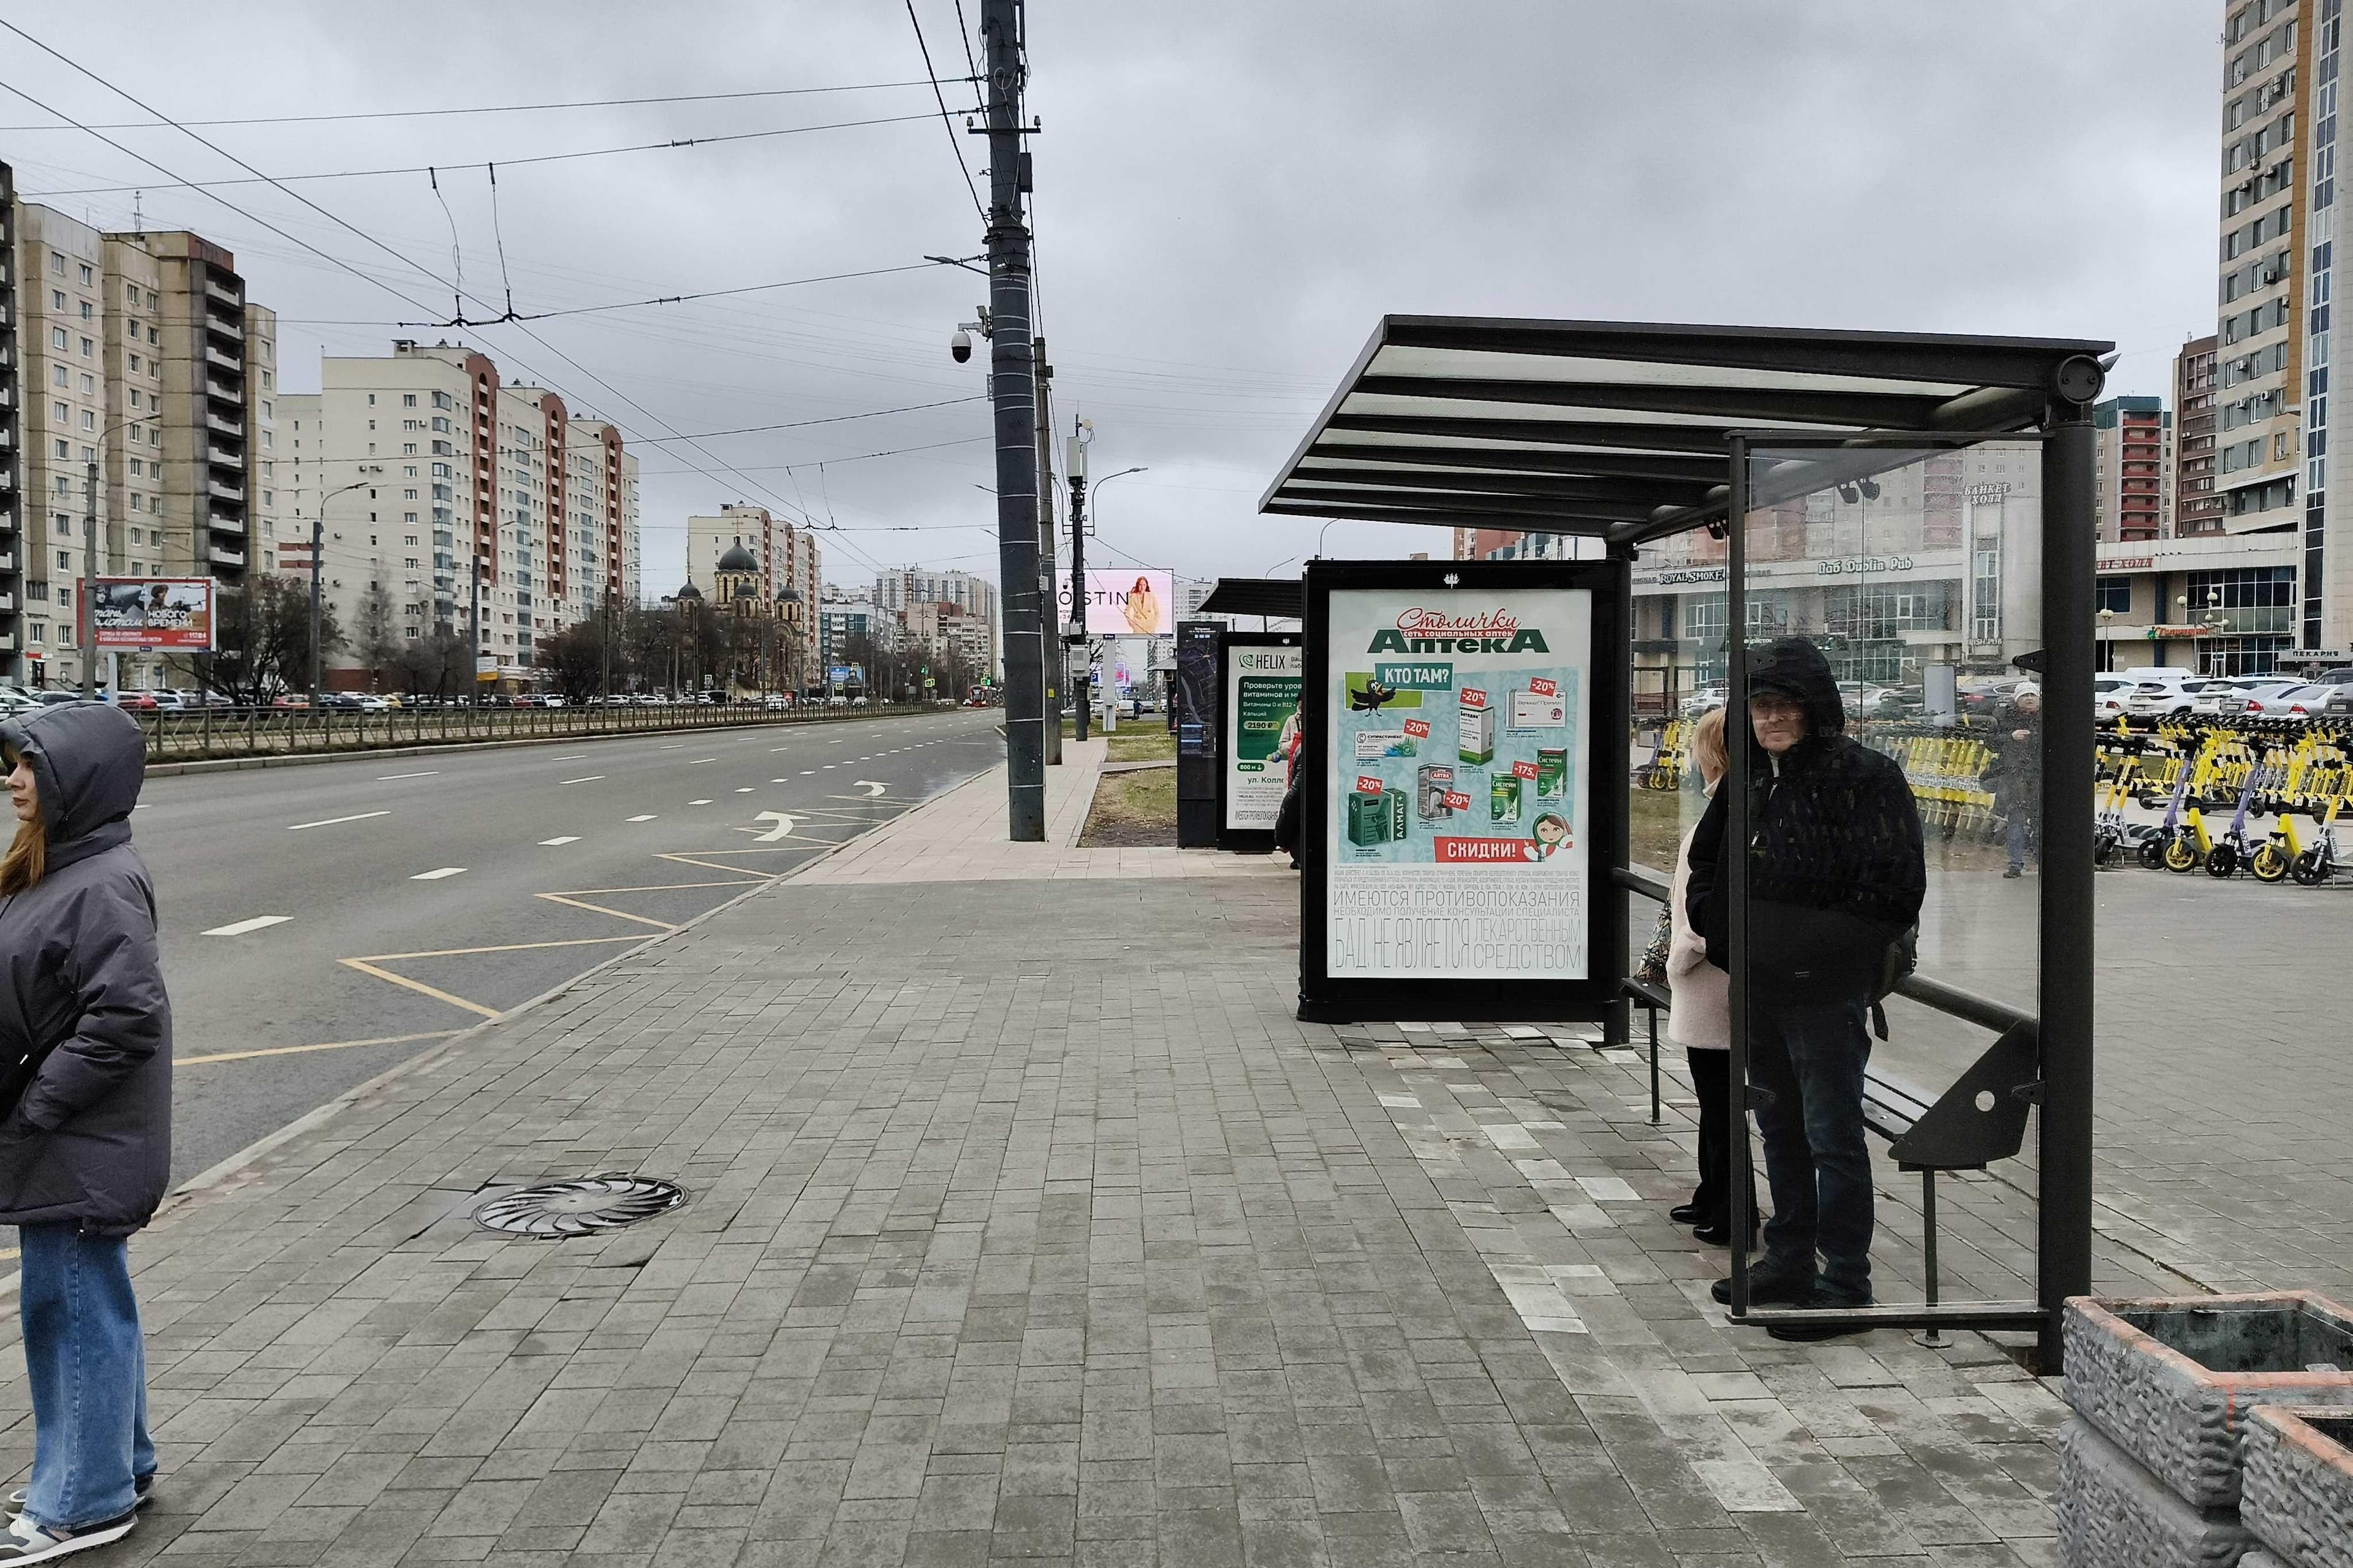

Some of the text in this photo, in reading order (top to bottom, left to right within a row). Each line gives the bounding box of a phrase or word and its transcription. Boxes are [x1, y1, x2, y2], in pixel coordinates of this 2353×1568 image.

[1890, 556, 1913, 571] Pub
[1659, 573, 1688, 585] ROYAL
[1688, 569, 1726, 583] SMOKE
[1396, 607, 1522, 630] Столички
[1256, 654, 1286, 669] HELIX
[1385, 668, 1450, 683] КТО ТАМ?
[1532, 680, 1555, 692] -20%
[1462, 691, 1485, 703] -20%
[1406, 722, 1429, 733] -20%
[1358, 779, 1381, 790] -20%
[1446, 795, 1469, 805] -20%
[1447, 841, 1517, 858] СКИДКИ!
[1334, 890, 1580, 907] ИМЕЮТСЯ ПРОТИВОПОКАЗАНИЯ
[1333, 907, 1580, 917] НЕОБХОДИМО ПОЛУЧЕНИЕ КОНСУЛЬТАЦИИ СПЕЦИАЛИСТА
[1474, 918, 1581, 942] ЛЕКАРСТВЕННЫМ
[1374, 918, 1391, 968] НЕ
[1395, 918, 1469, 969] ЯВЛЯЕТСЯ
[1474, 944, 1581, 971] СРЕДСТВОМ
